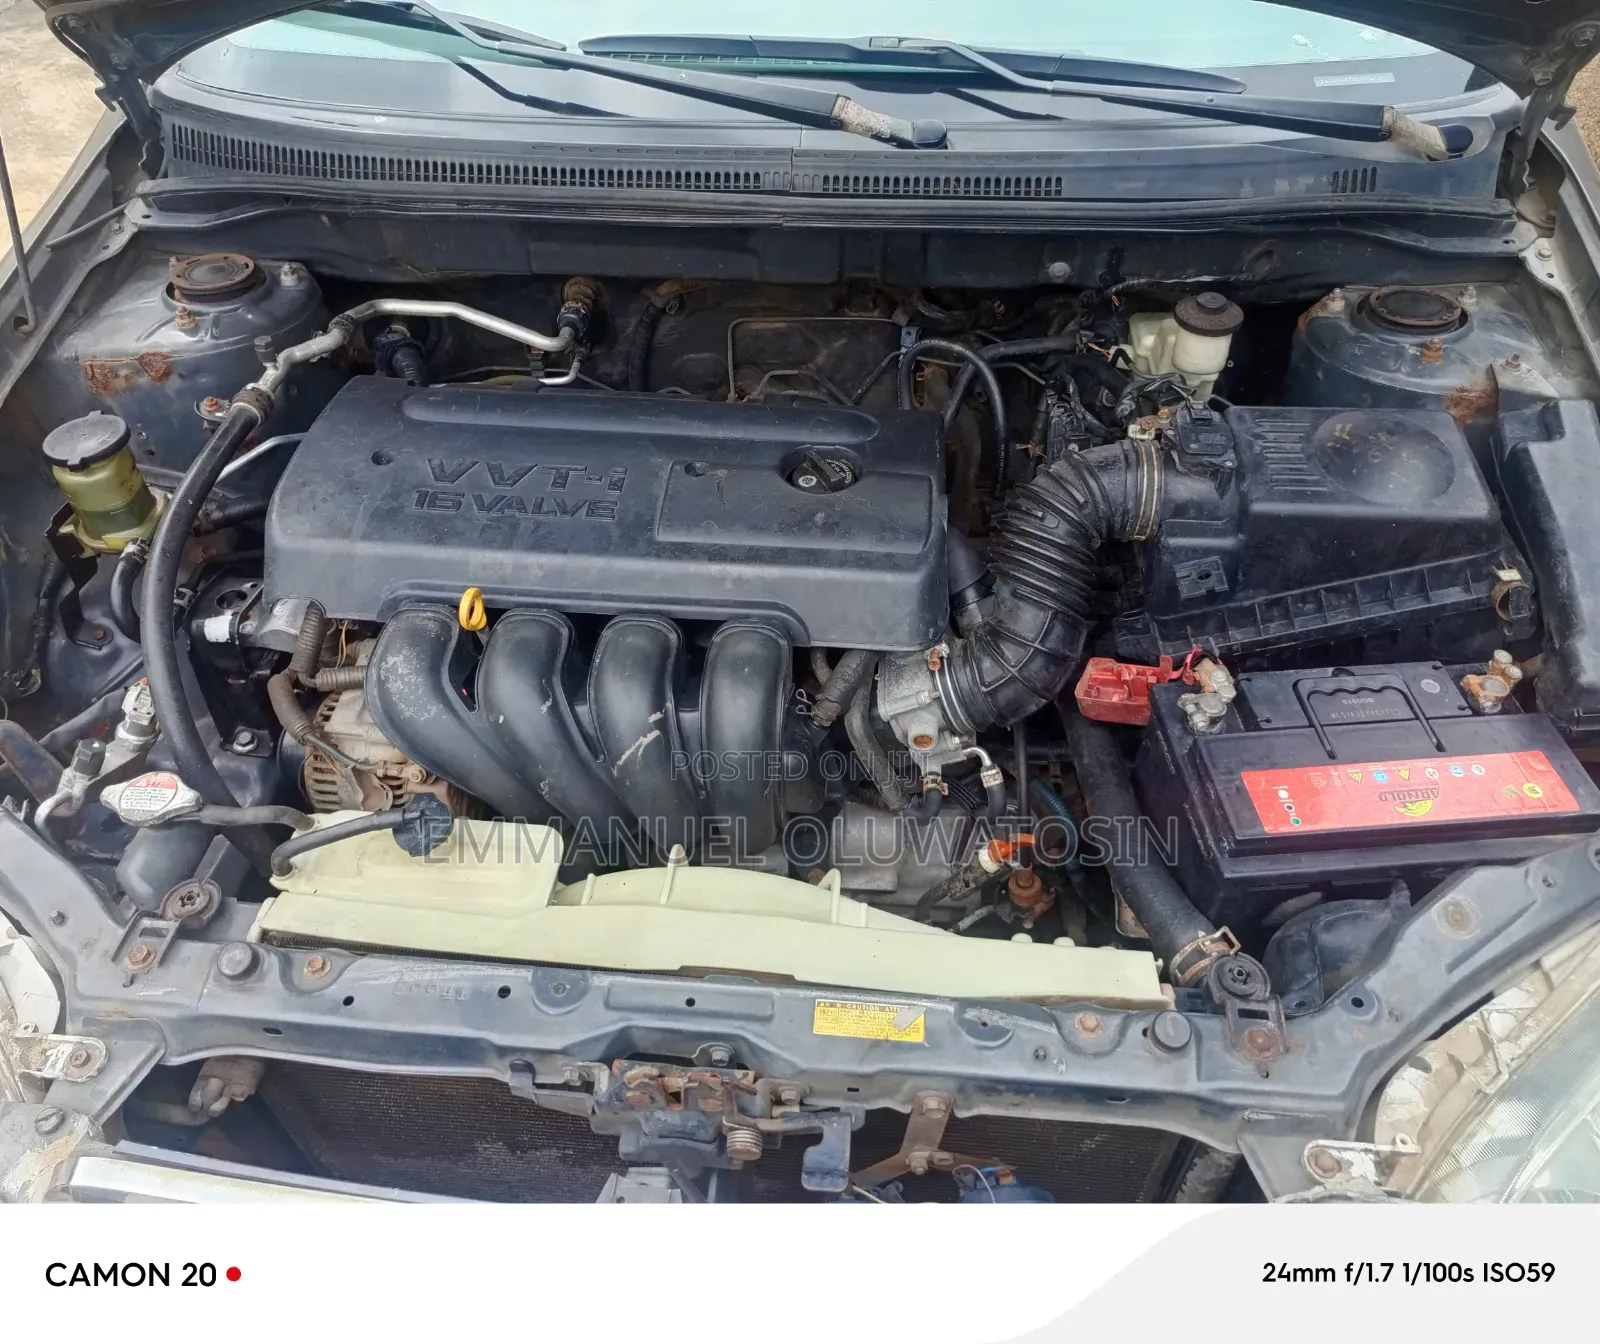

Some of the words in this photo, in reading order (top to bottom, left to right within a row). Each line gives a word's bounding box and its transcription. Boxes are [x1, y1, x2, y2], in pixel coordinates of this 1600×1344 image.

[426, 457, 628, 494] VVT-i
[412, 488, 465, 513] 16
[470, 493, 619, 521] VALVE
[1378, 787, 1440, 801] ARNOLD
[846, 1003, 880, 1011] CAUTION
